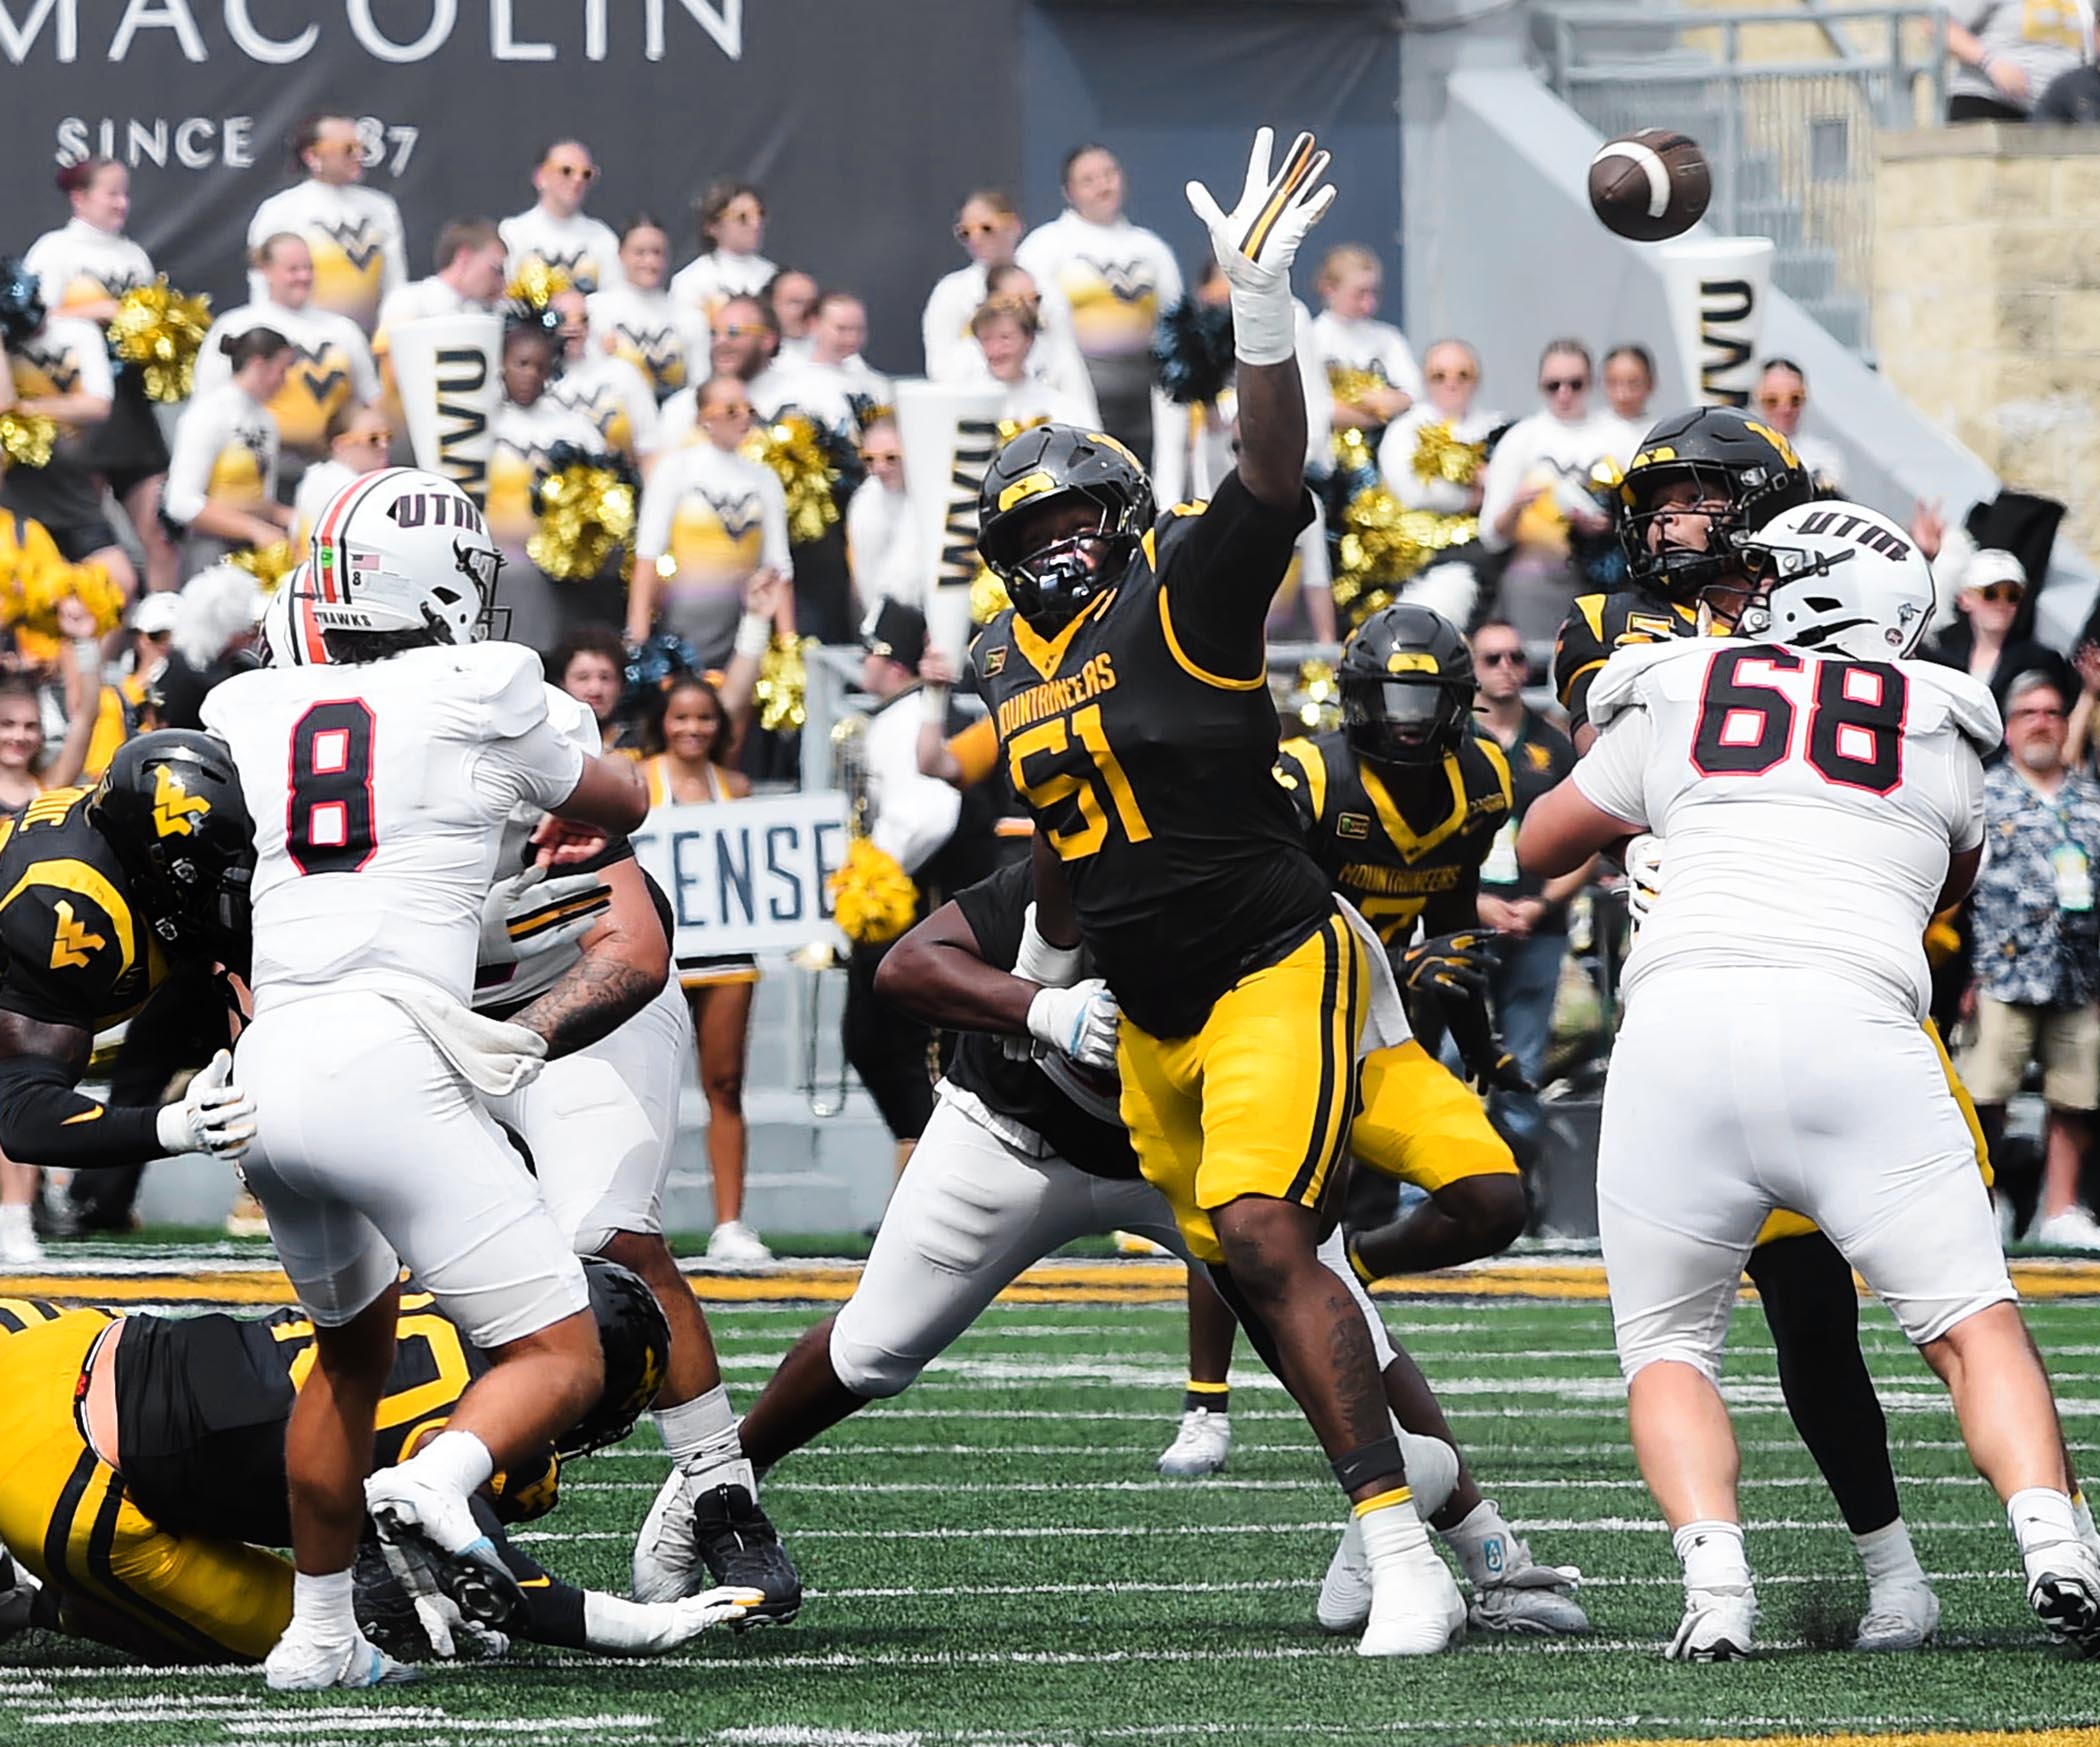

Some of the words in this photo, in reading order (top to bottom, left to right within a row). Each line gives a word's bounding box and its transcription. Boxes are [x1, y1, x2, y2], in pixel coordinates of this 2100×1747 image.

[55, 116, 256, 168] SINCE
[398, 493, 482, 535] UTM
[1797, 511, 1911, 562] UTM
[997, 652, 1117, 741] OUNTAINEERS
[1689, 643, 1910, 799] 68
[286, 696, 378, 875] 8
[1008, 703, 1153, 862] 51
[630, 823, 842, 928] ENSE
